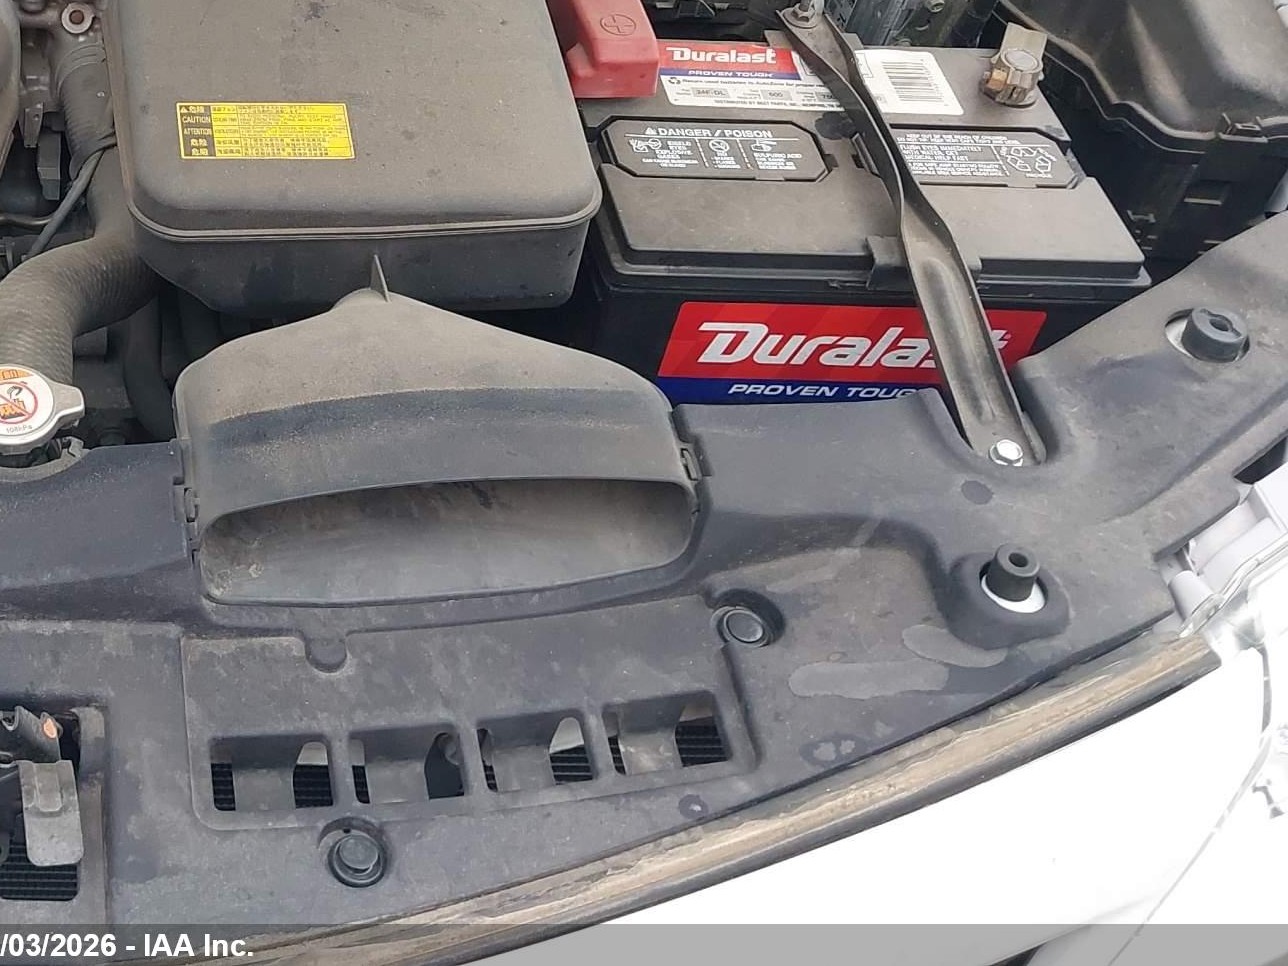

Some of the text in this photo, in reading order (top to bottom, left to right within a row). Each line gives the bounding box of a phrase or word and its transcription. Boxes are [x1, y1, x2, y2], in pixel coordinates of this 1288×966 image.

[665, 46, 777, 64] Duralast
[182, 115, 211, 124] CAUTION
[658, 127, 712, 137] DANGER
[724, 129, 773, 138] POISON
[696, 321, 1010, 369] Durala
[727, 383, 918, 398] PROVEN TOUG
